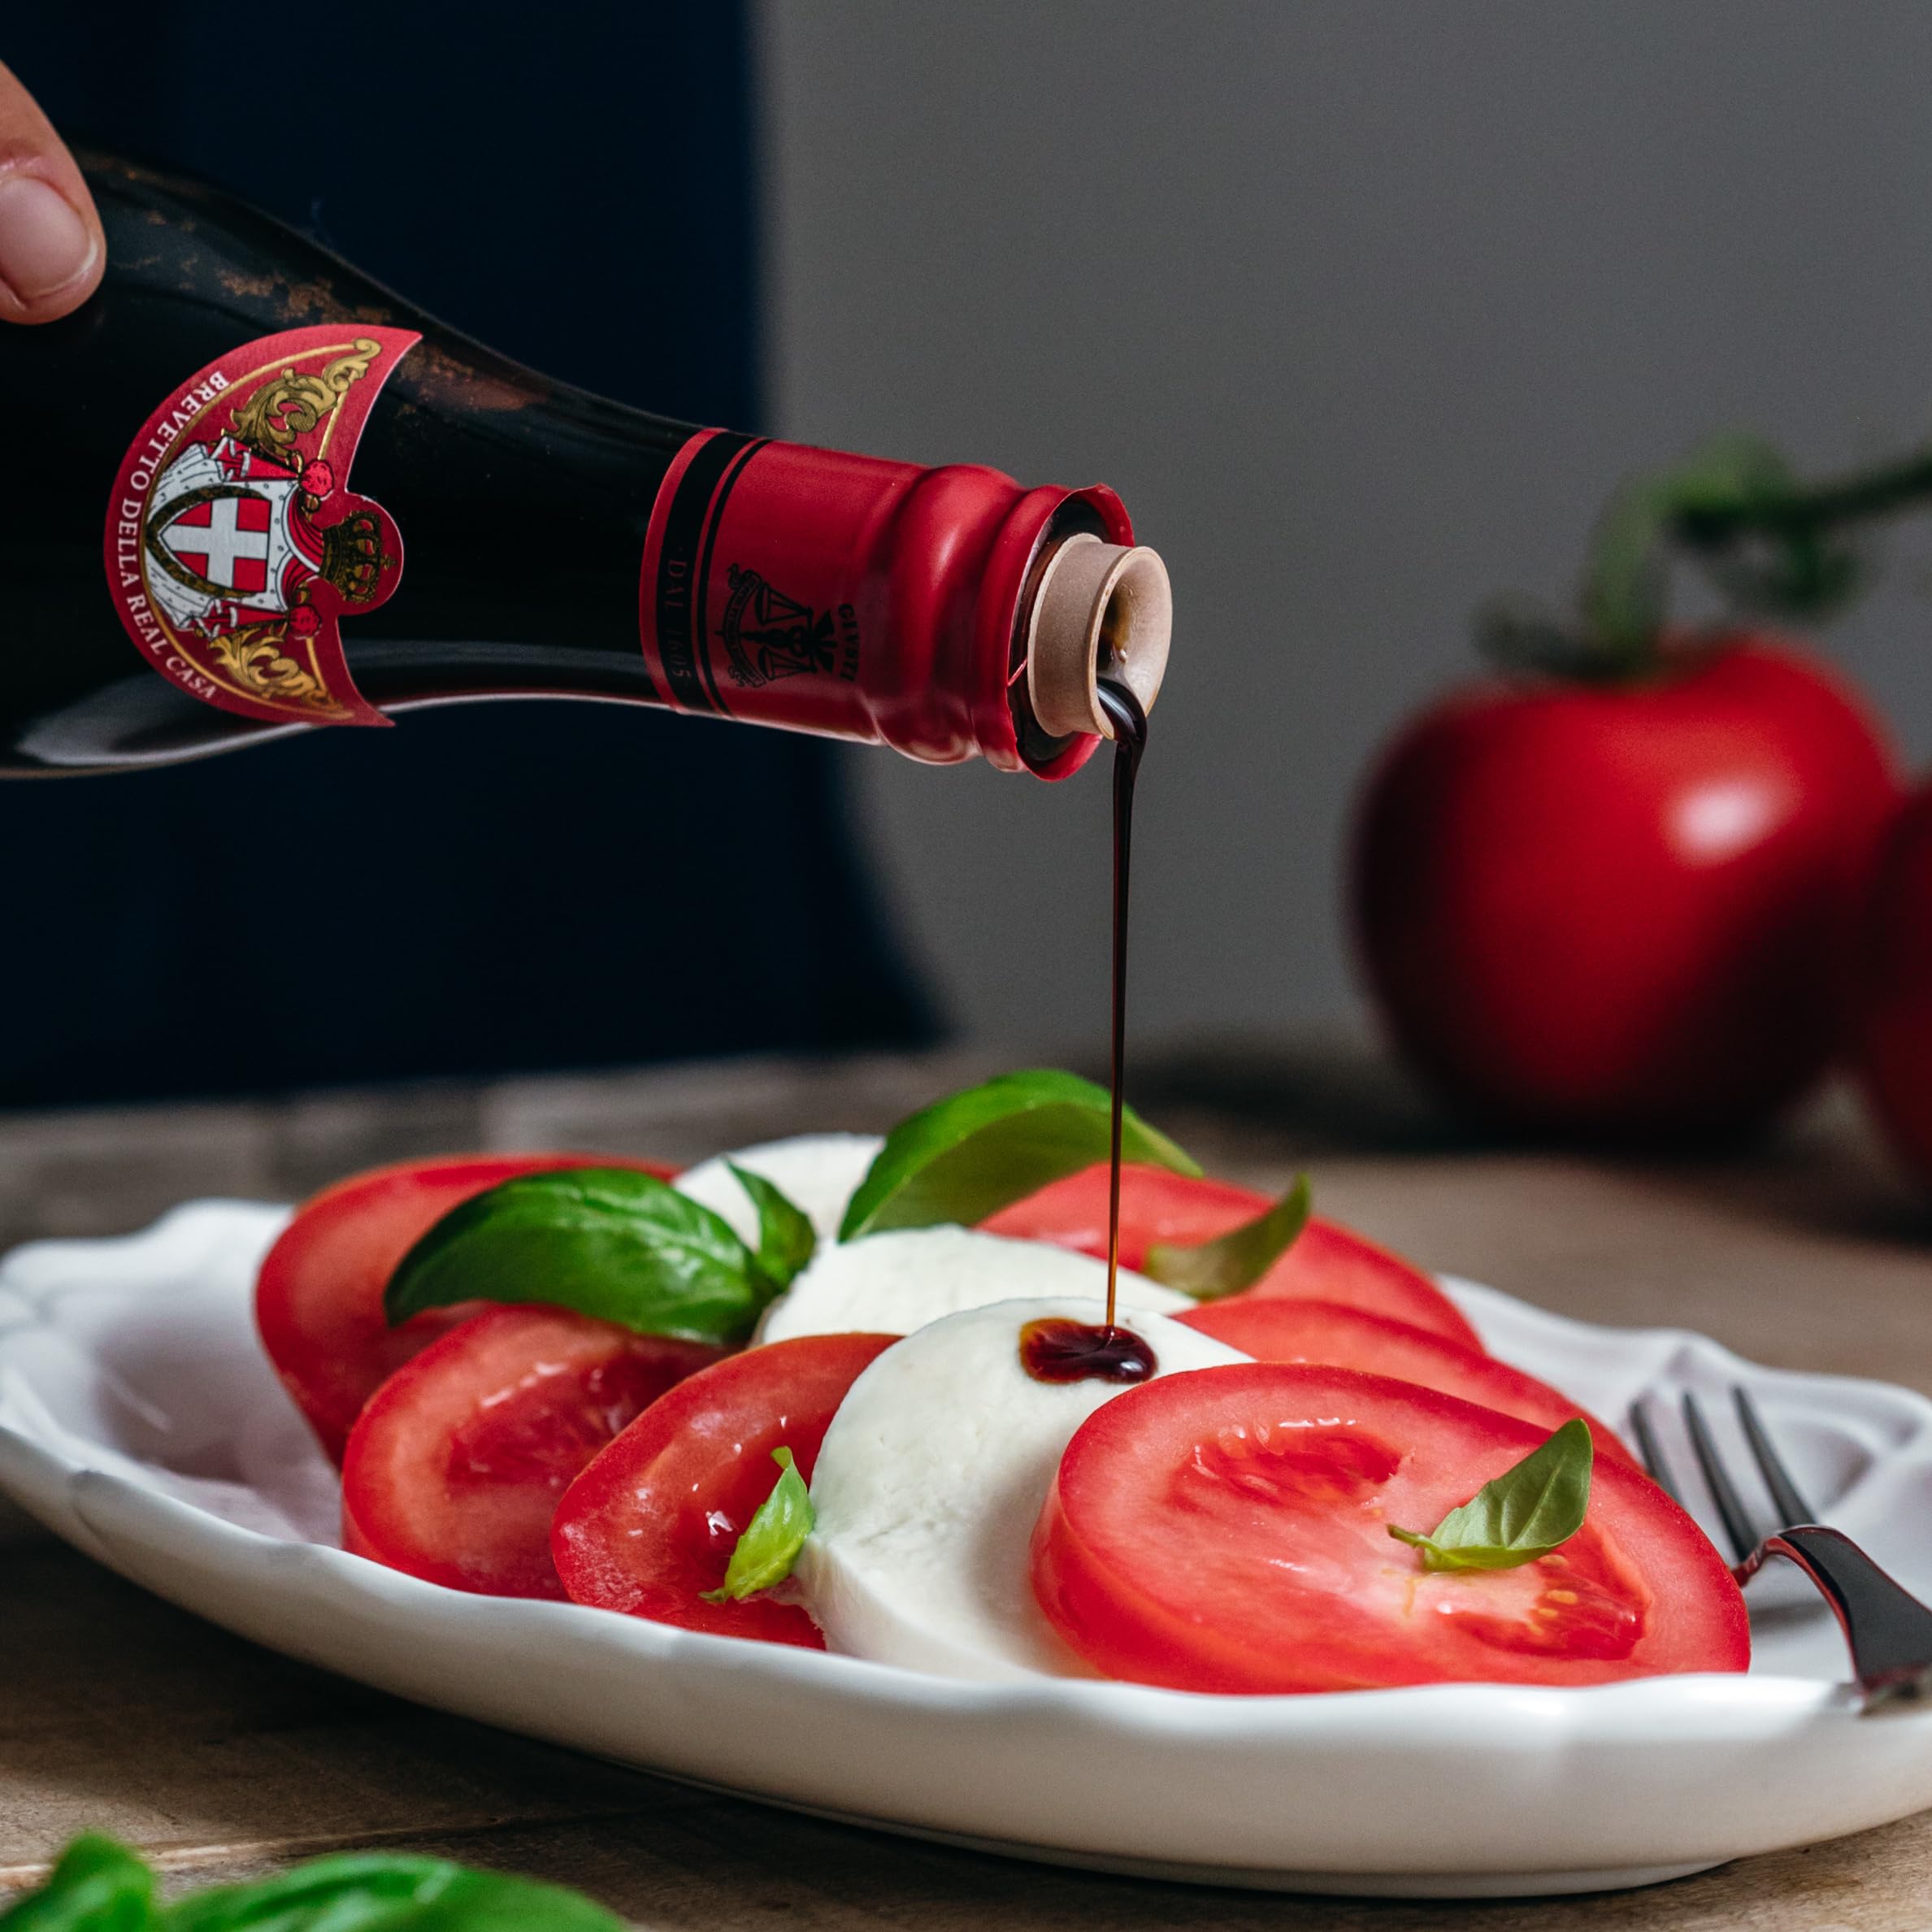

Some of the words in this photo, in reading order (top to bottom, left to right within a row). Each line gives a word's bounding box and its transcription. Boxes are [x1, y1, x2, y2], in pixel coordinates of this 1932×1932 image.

[131, 371, 229, 491] BREVETTO
[118, 497, 141, 587] DELLA
[666, 559, 687, 607] DAL
[127, 596, 167, 655] REAL
[166, 655, 217, 701] CASA
